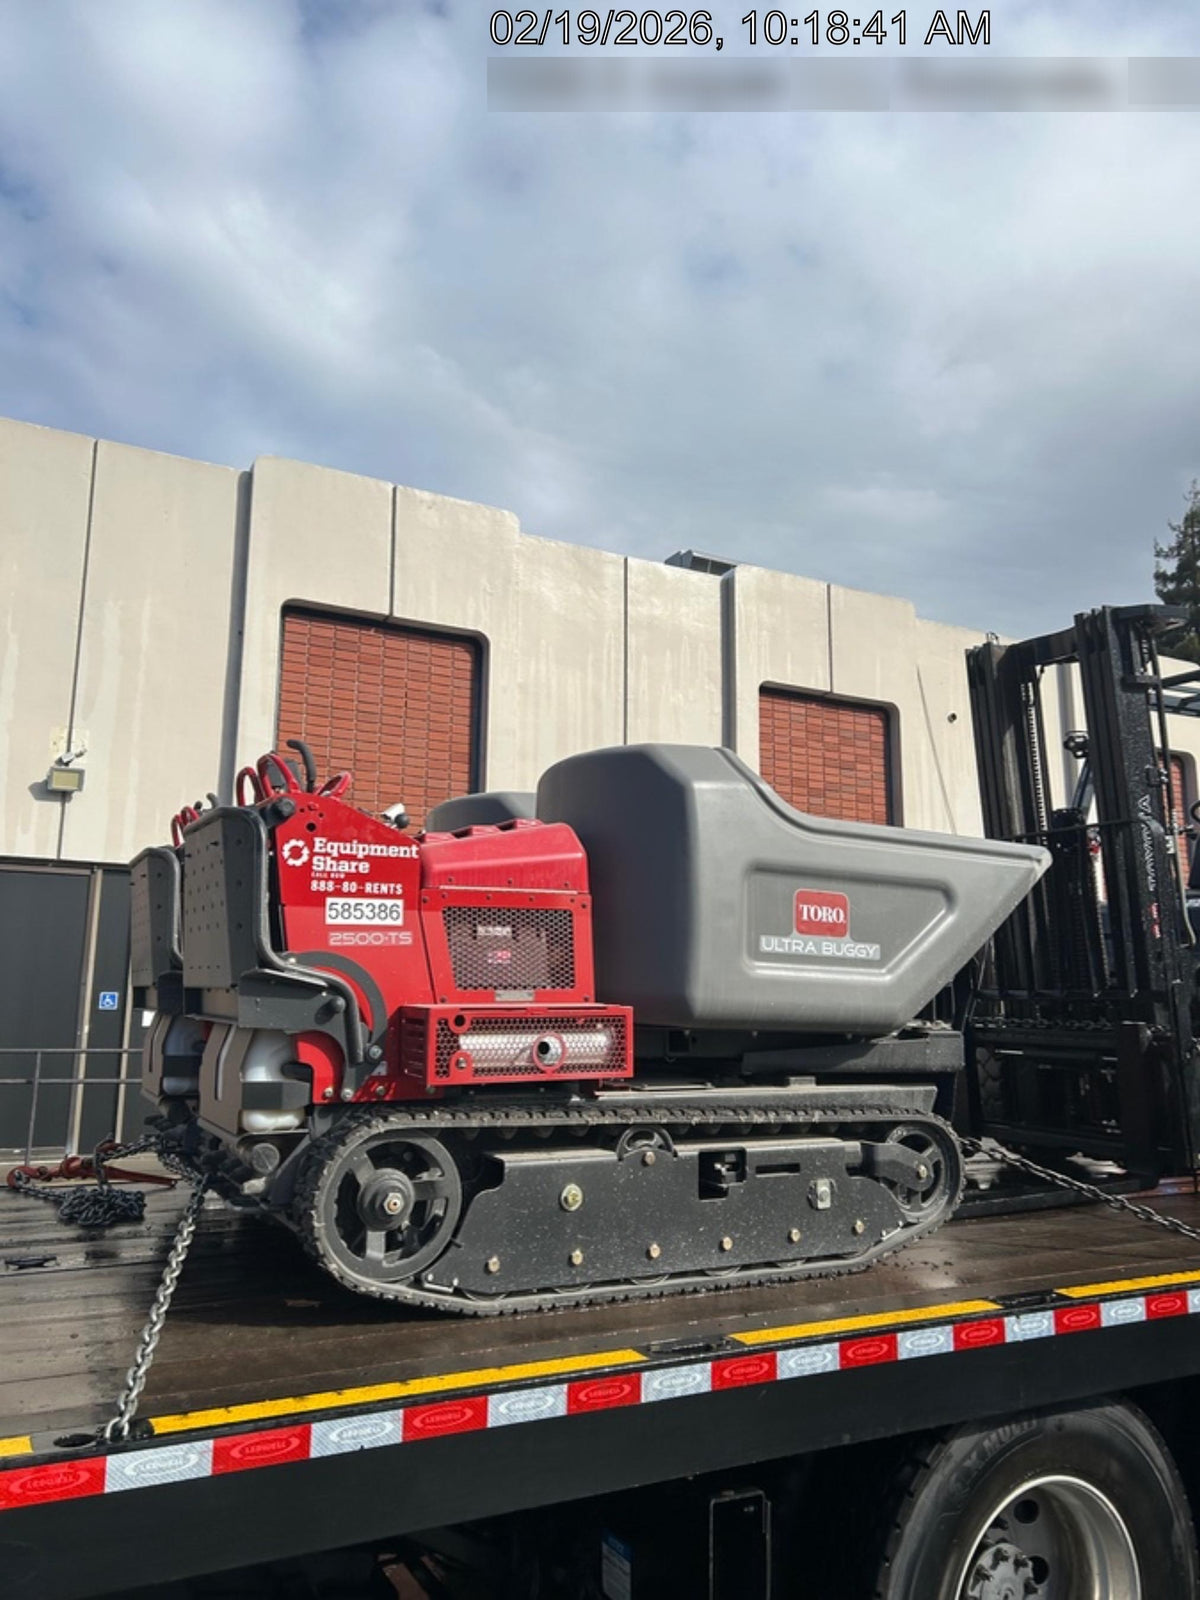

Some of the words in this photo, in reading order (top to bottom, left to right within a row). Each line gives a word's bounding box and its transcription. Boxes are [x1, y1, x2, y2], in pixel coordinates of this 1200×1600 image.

[312, 837, 420, 859] Equipment
[311, 856, 370, 874] Share
[327, 902, 401, 921] 585386
[799, 904, 845, 924] TORO
[761, 936, 817, 955] ULTRA
[821, 942, 879, 958] BUGGY
